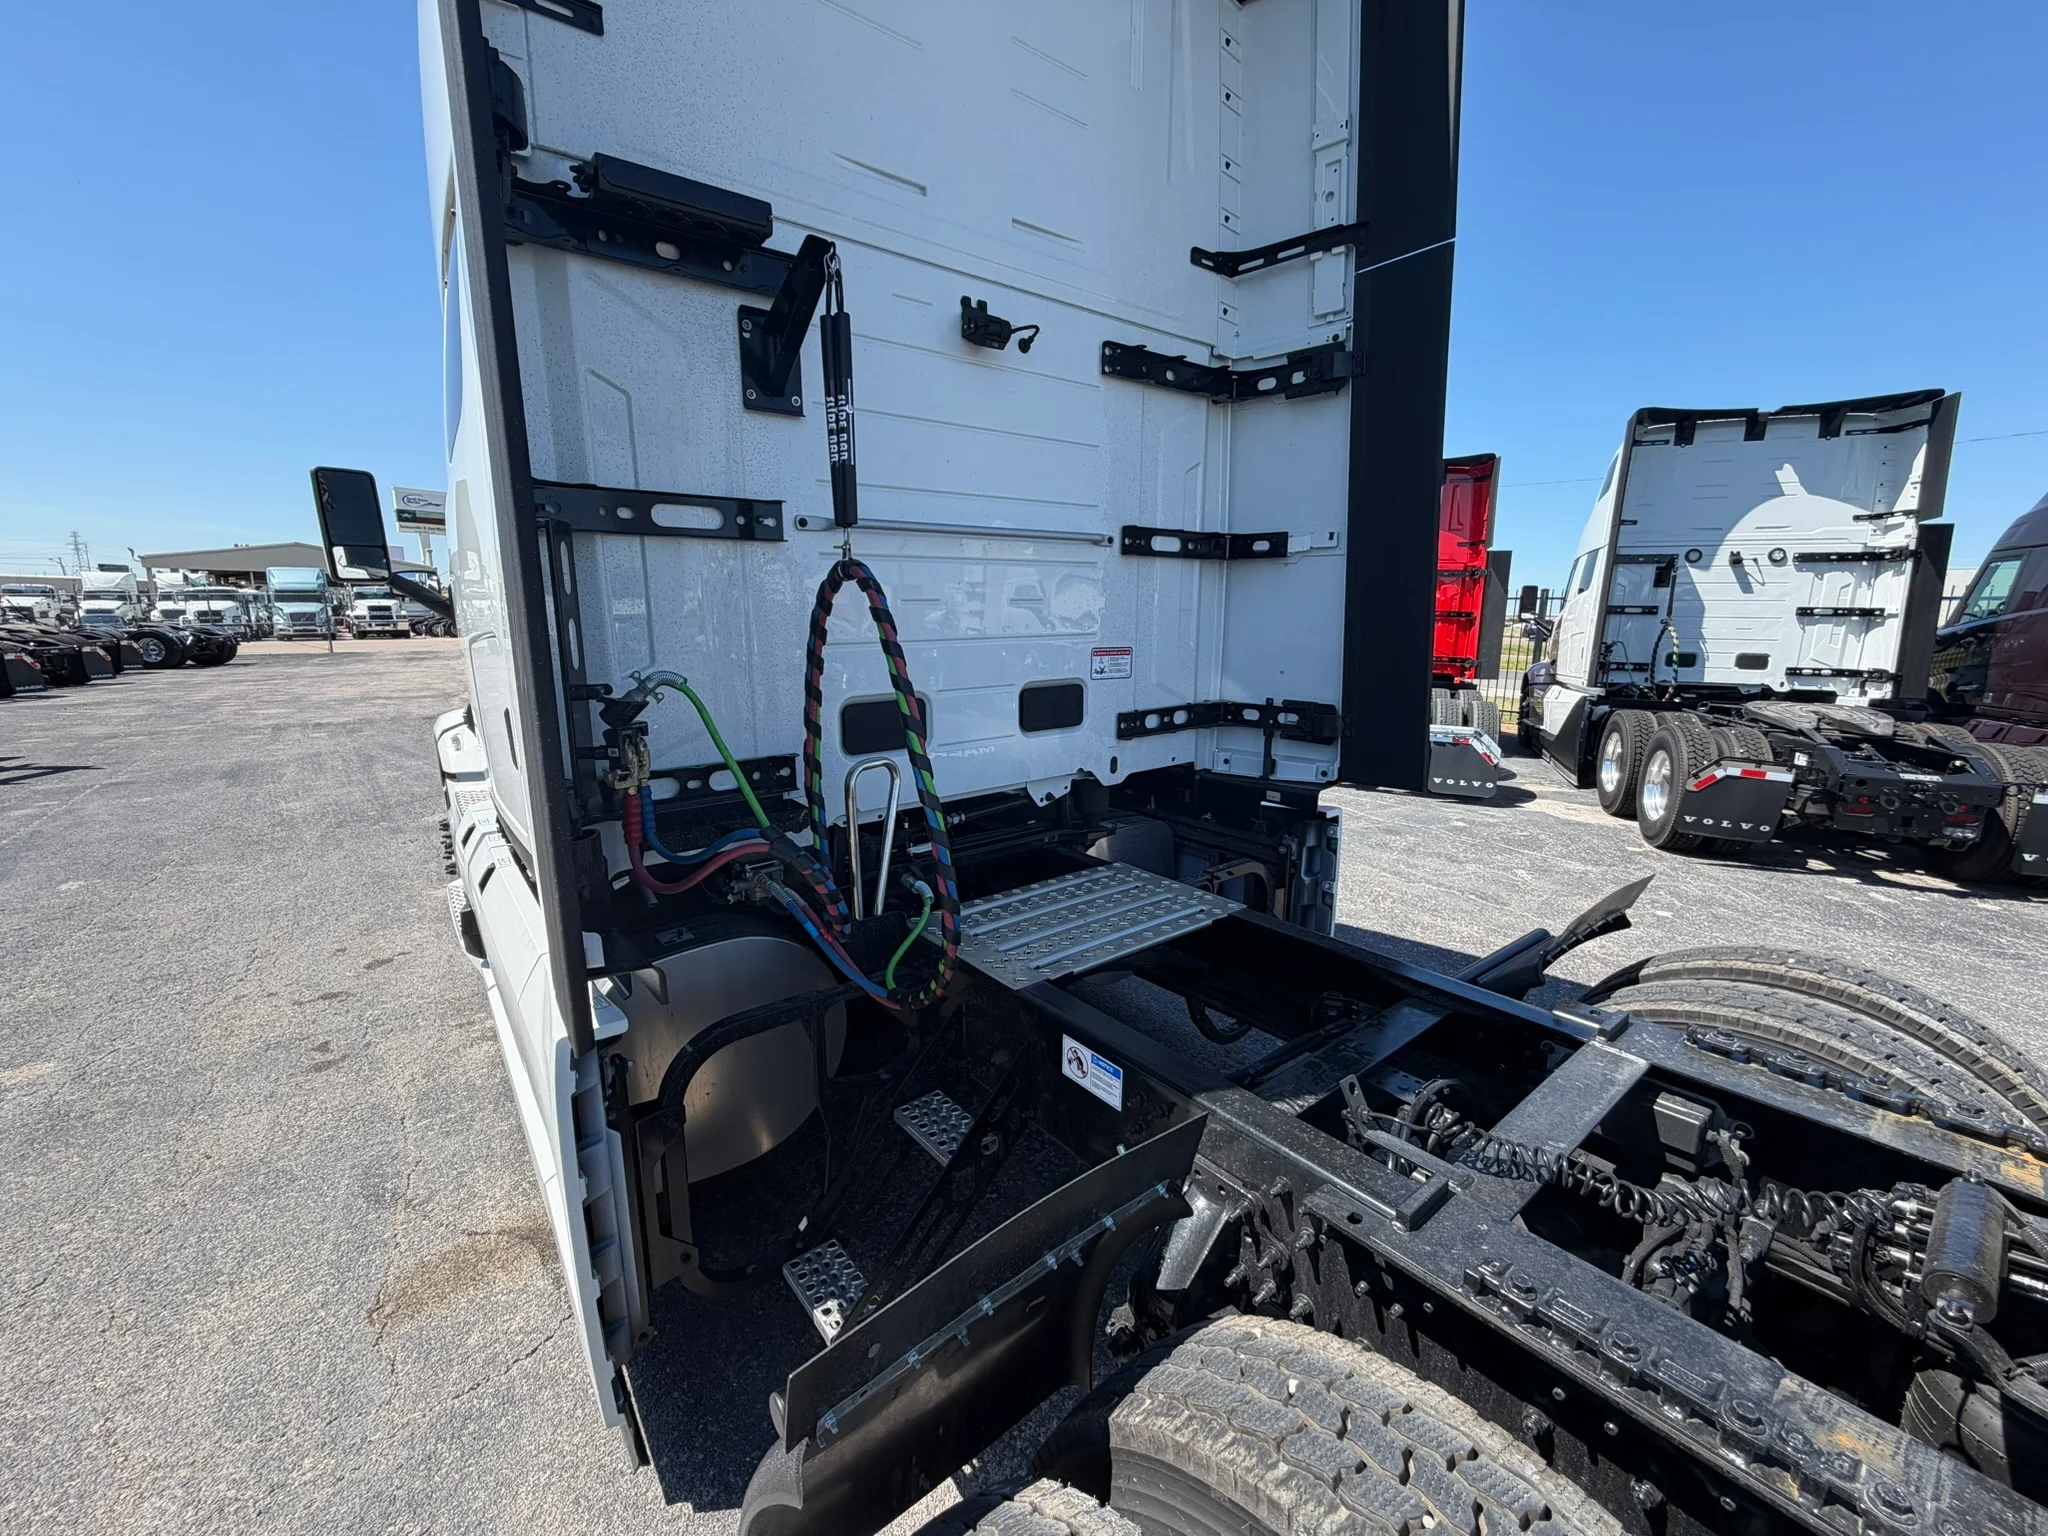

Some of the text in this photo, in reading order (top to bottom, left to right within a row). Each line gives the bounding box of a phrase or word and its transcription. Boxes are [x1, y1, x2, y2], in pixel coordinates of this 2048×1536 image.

[826, 396, 839, 463] SLIDE BAR
[838, 394, 850, 461] SLIDE BAR
[1433, 777, 1495, 789] VOLVO
[1683, 814, 1771, 833] VOLVO
[2021, 853, 2048, 863] V
